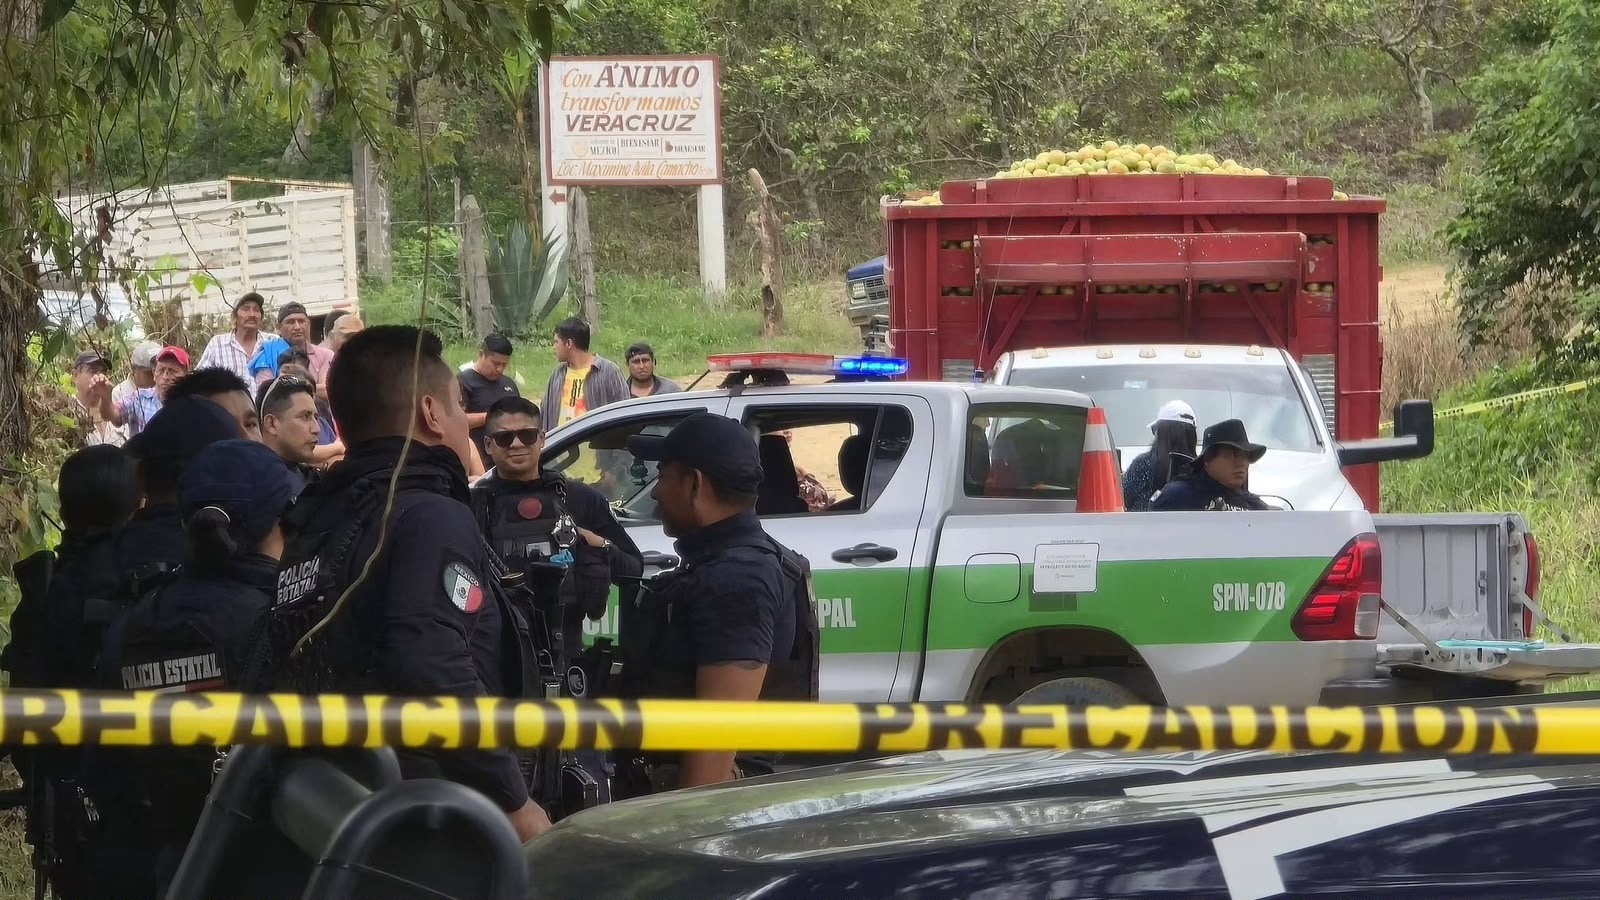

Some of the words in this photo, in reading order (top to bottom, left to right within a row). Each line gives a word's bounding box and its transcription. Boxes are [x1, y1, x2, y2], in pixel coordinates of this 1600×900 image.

[562, 67, 592, 88] Con
[565, 114, 696, 132] VERACRUZ
[620, 138, 660, 148] BIENESTAR
[656, 160, 700, 179] Camacho
[277, 574, 317, 605] ESTATAL
[1212, 581, 1286, 612] SPM-078
[163, 652, 222, 685] ESTATAL
[859, 702, 1539, 755] PRECAUCION
